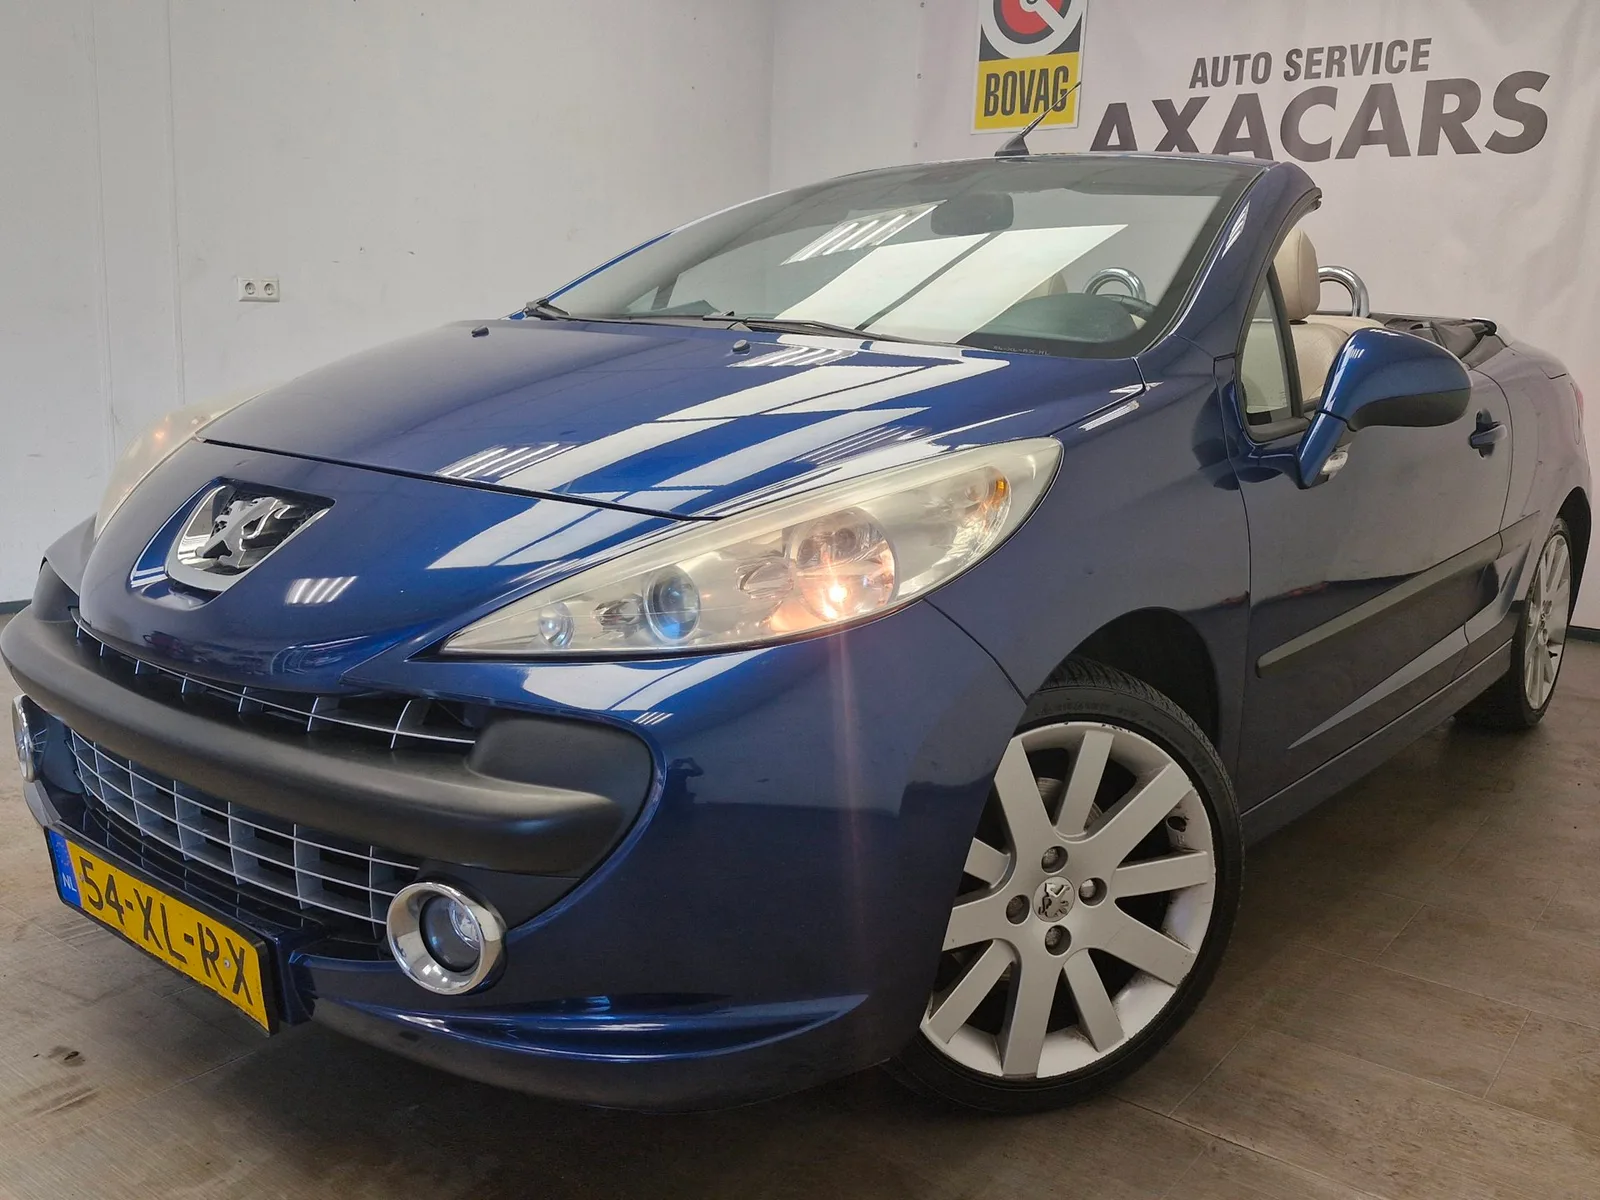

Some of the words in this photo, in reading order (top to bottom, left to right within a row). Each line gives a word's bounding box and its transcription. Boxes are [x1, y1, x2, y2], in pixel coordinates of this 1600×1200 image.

[1189, 52, 1273, 89] AUTO
[1284, 38, 1432, 82] SERVICE
[984, 65, 1069, 117] BOVAG
[1090, 71, 1550, 162] AXACARS
[62, 873, 77, 892] NL
[80, 856, 253, 1006] 54-XL-RX
